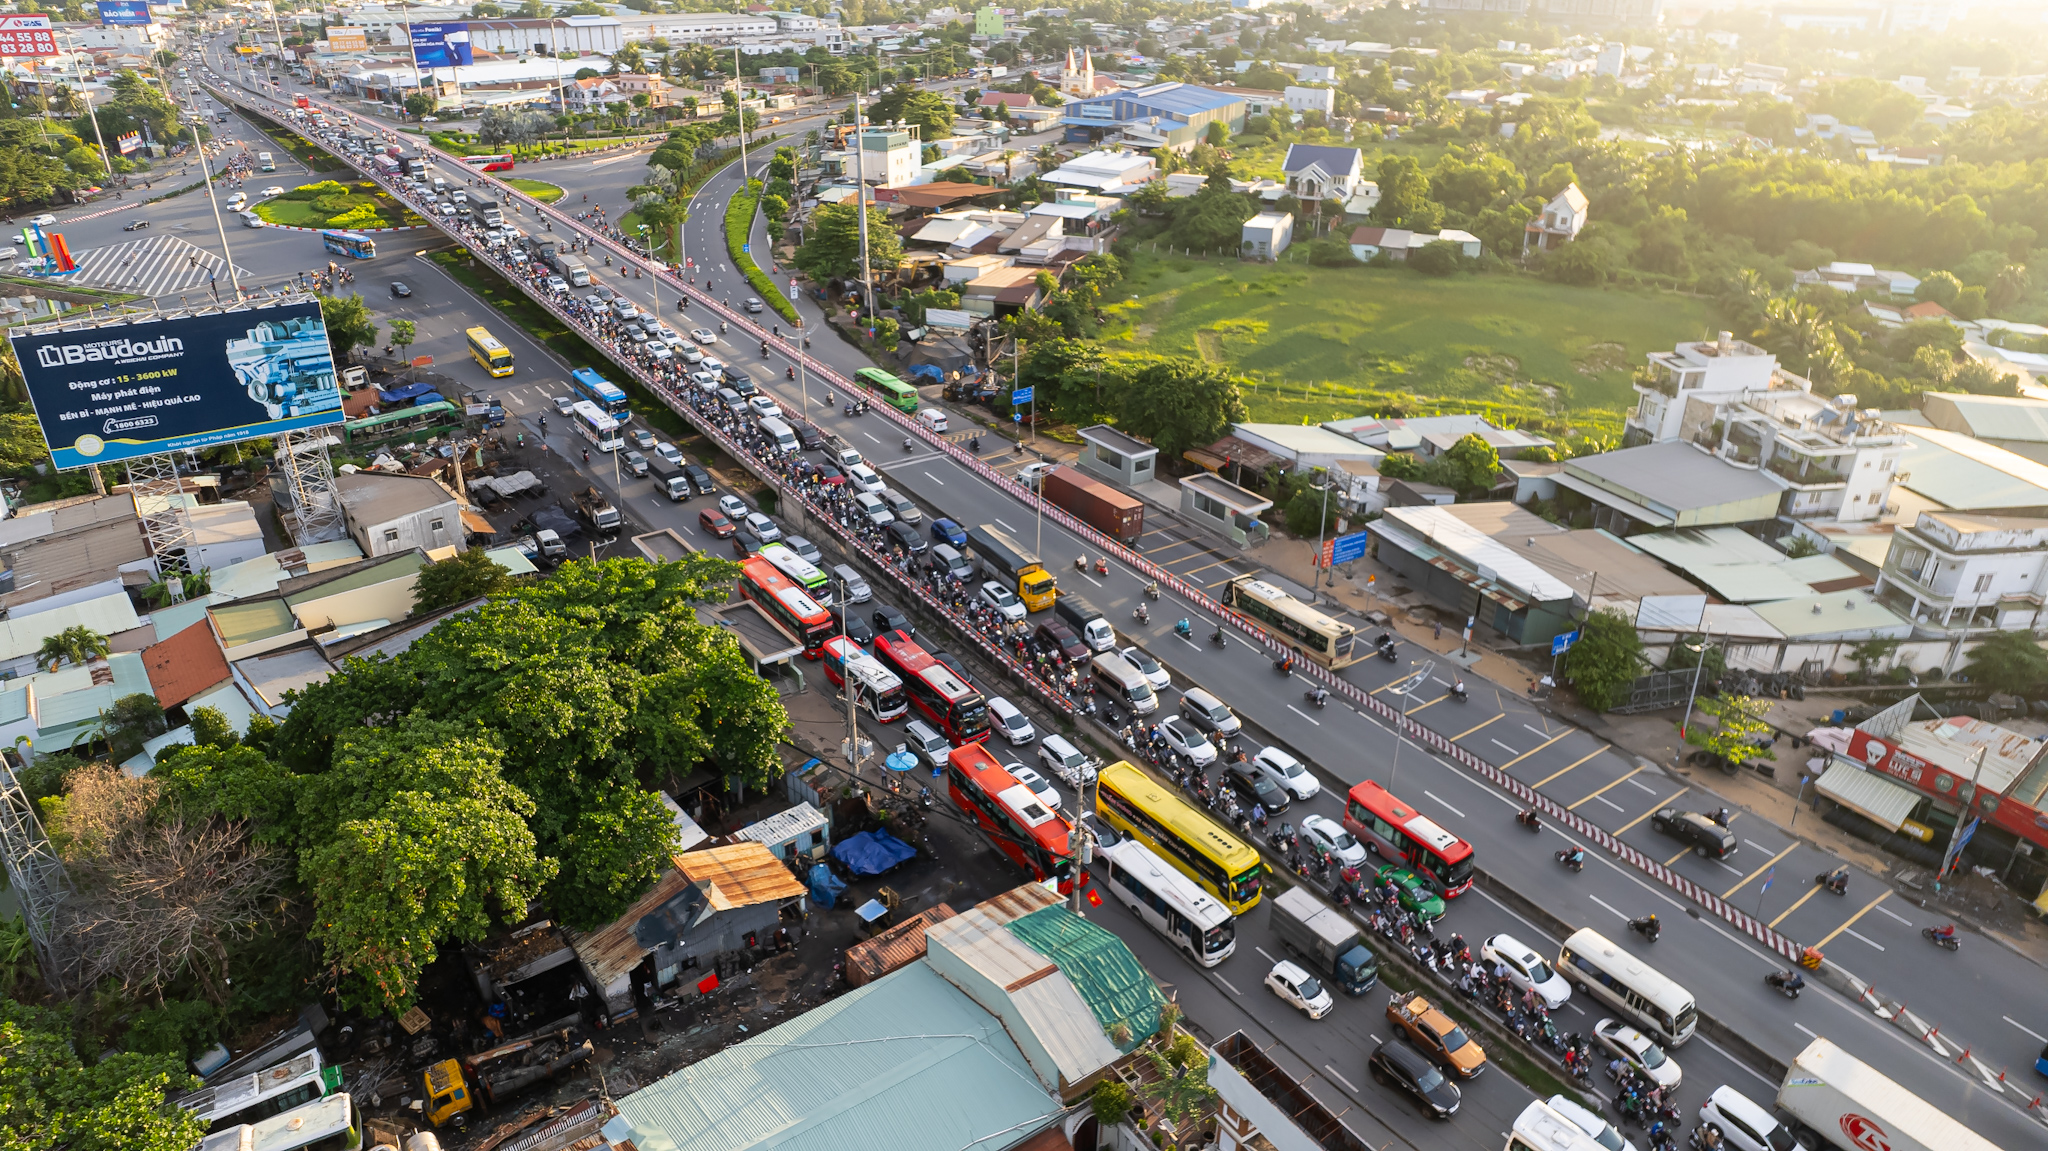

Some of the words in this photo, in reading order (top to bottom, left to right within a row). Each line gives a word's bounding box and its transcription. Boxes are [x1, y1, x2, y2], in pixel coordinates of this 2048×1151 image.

[16, 33, 32, 42] 55
[34, 32, 50, 42] 88
[1, 44, 17, 53] 83
[18, 43, 35, 53] 28
[37, 43, 54, 52] 80
[83, 339, 123, 349] MOTEURS
[62, 335, 184, 365] Baudouin
[148, 351, 184, 361] COMPANY
[68, 380, 97, 391] Động
[98, 378, 111, 386] cơ
[117, 375, 130, 383] 15
[137, 371, 161, 381] 3600
[162, 368, 178, 377] kW
[91, 391, 113, 402] Máy
[115, 388, 138, 400] phát
[139, 386, 162, 396] điện
[95, 404, 123, 416] MẠNH
[142, 399, 163, 409] HIỆU
[184, 394, 201, 403] CAO
[114, 421, 134, 429] 1800
[135, 418, 154, 427] 6323
